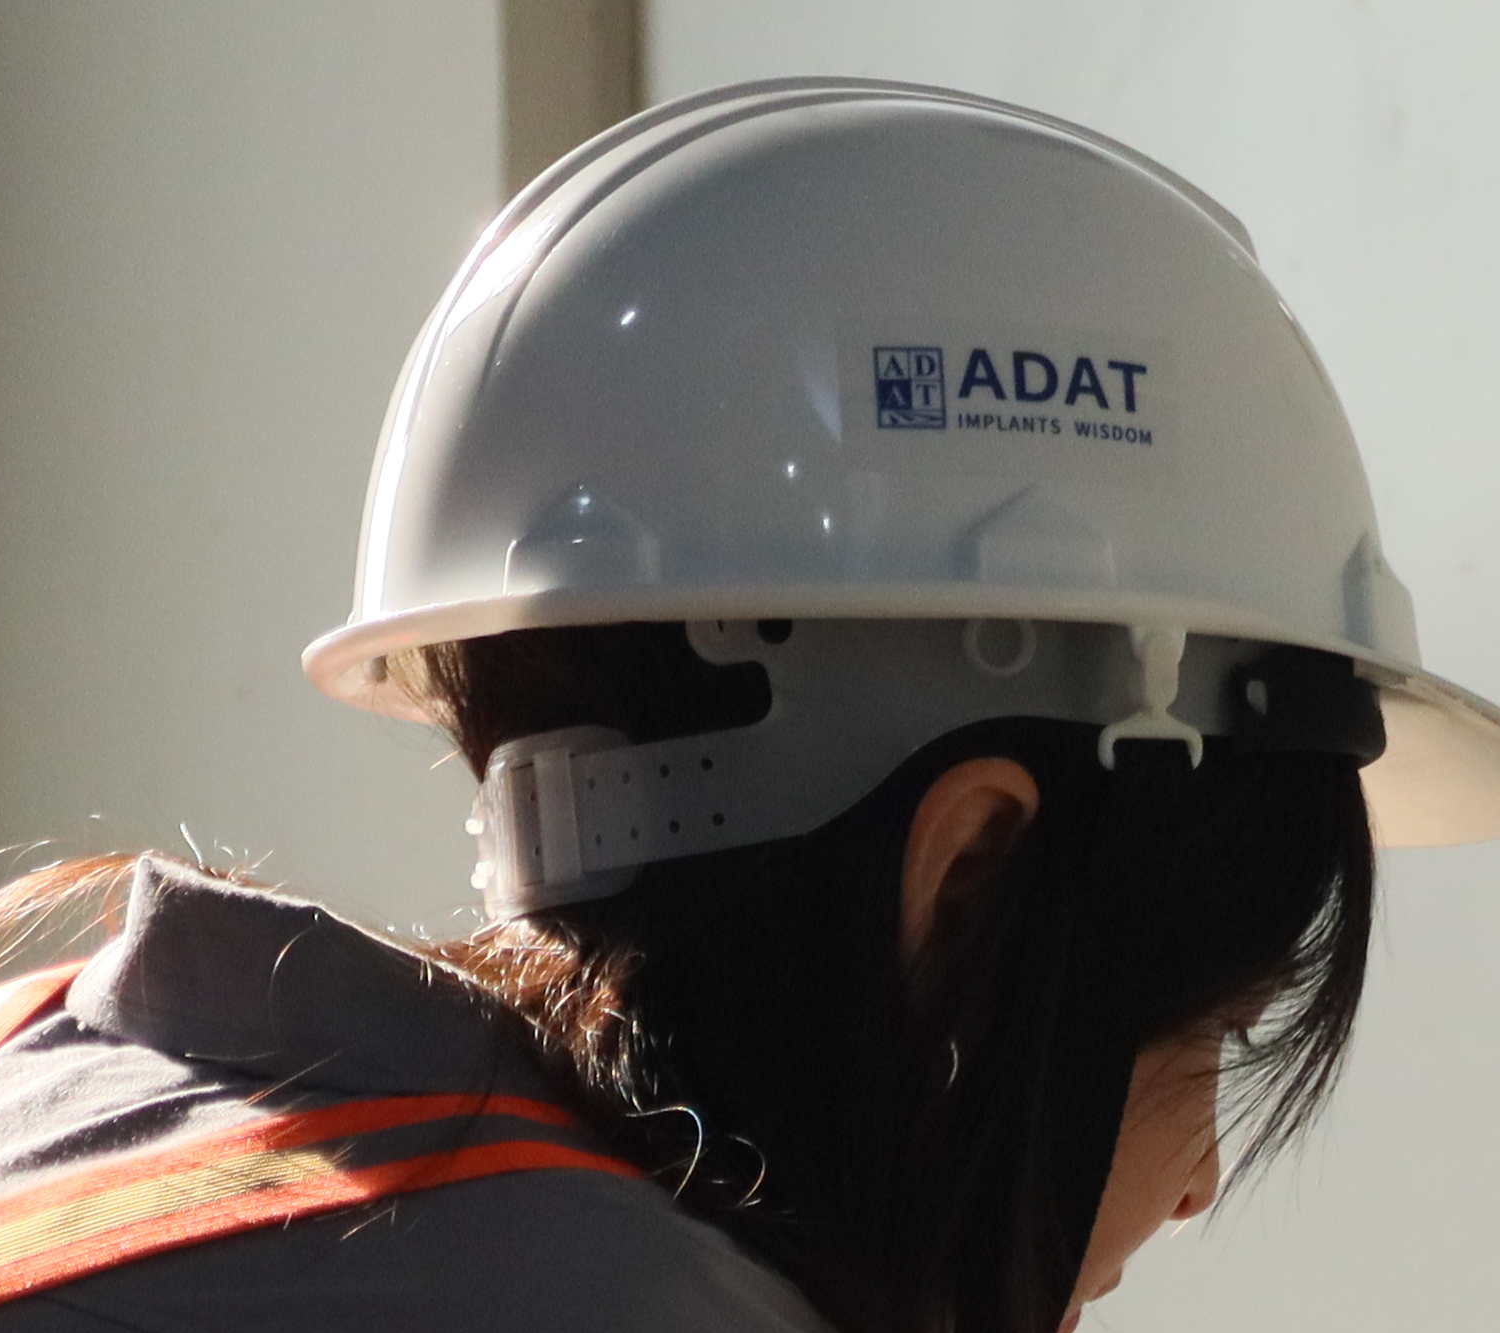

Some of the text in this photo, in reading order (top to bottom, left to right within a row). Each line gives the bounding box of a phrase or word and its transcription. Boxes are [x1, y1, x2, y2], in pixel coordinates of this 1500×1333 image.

[958, 348, 1148, 413] ADAT
[958, 413, 1153, 446] IMPLANTS WISDOM
